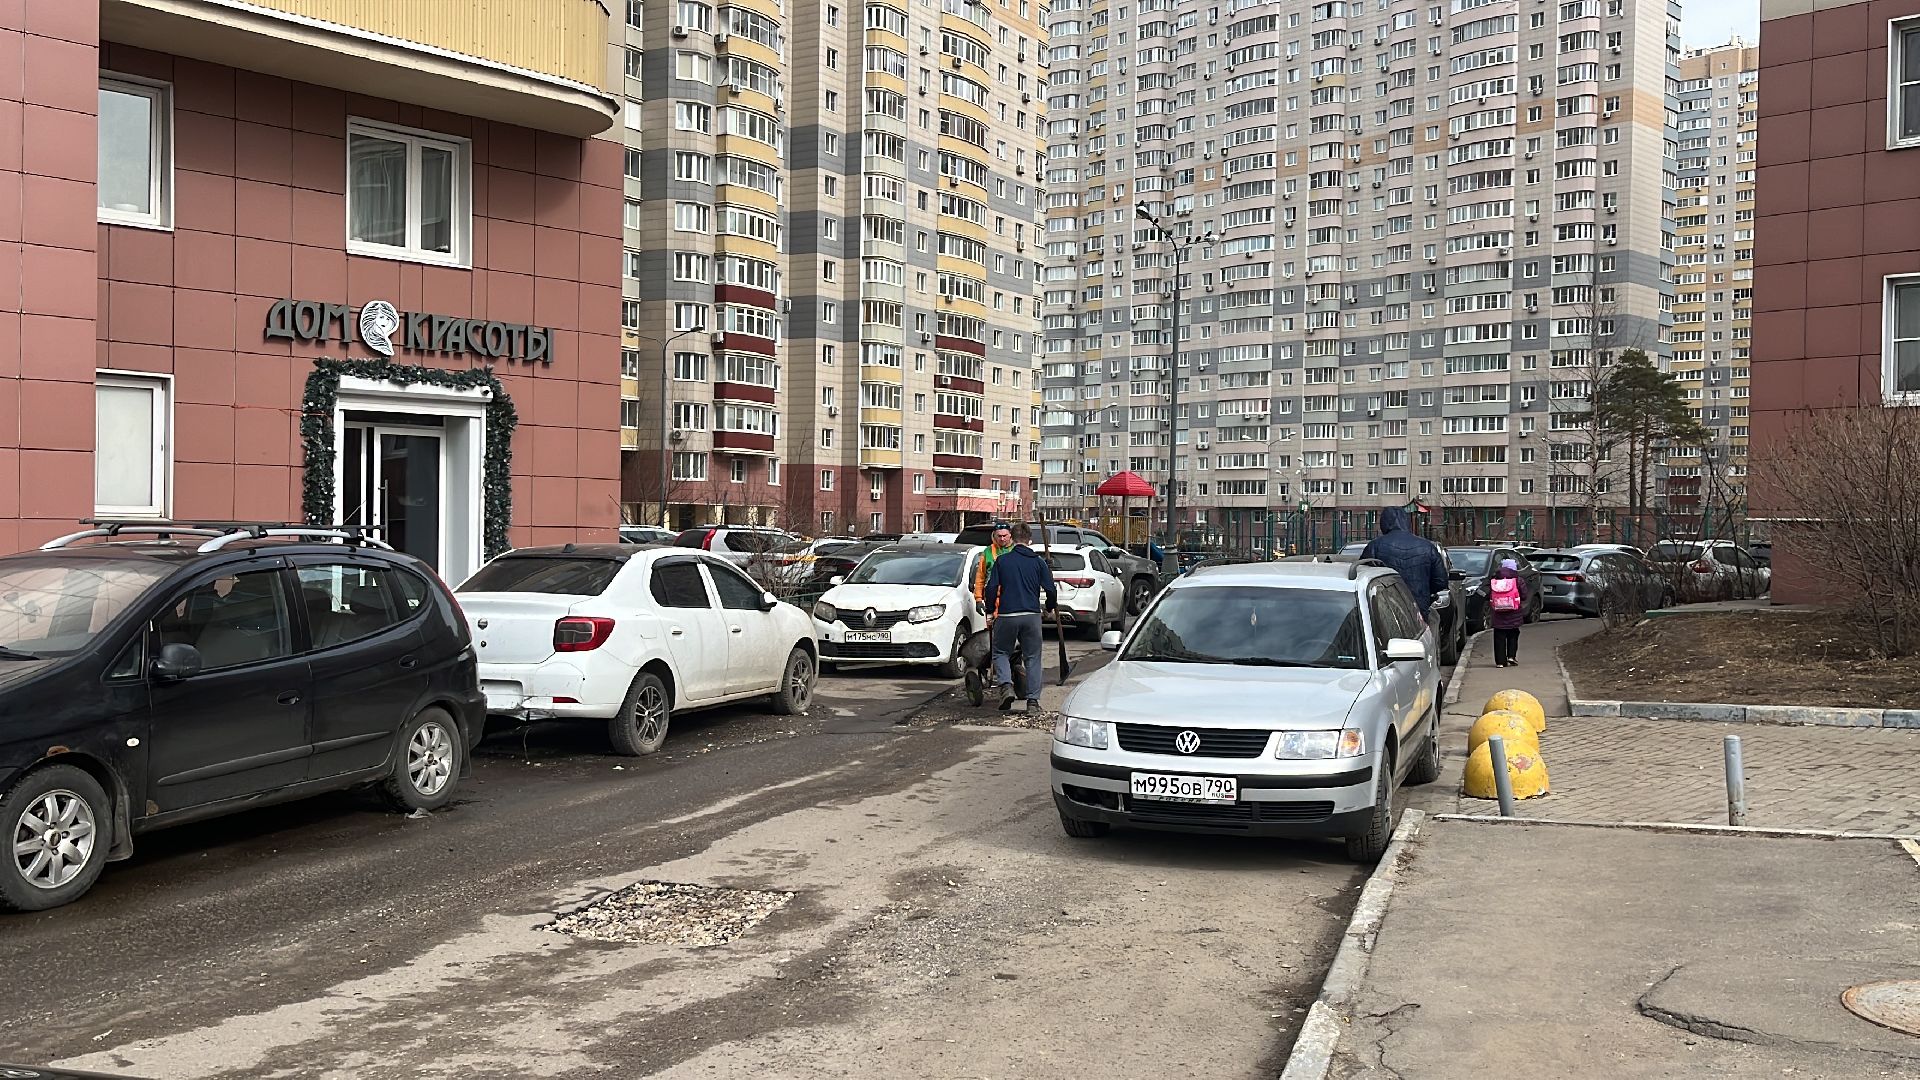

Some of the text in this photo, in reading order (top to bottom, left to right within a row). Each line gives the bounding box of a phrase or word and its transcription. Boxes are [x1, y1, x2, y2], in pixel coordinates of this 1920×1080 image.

[265, 299, 554, 362] ДОМ КРАСОТЫ
[1205, 779, 1232, 793] 790
